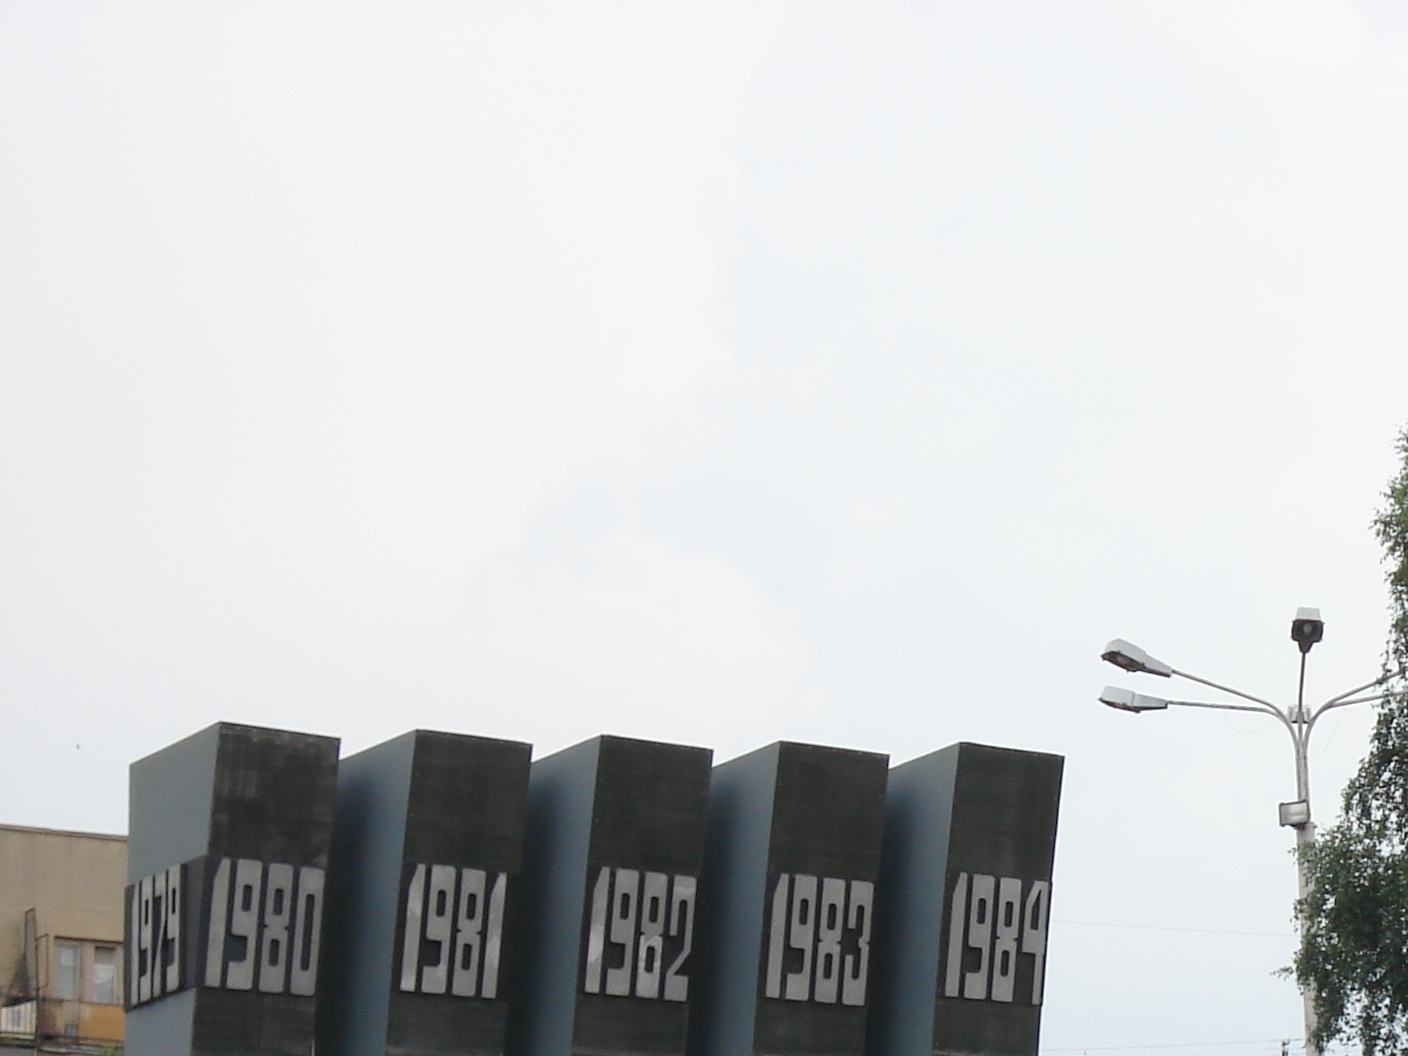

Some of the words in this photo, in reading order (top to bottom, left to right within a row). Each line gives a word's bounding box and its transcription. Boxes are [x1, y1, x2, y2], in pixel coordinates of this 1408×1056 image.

[130, 863, 181, 1006] 1979
[205, 858, 326, 996] 1980
[400, 863, 507, 999] 1981
[584, 866, 697, 1002] 1982
[765, 872, 875, 1006] 1983
[944, 872, 1049, 1006] 1984
